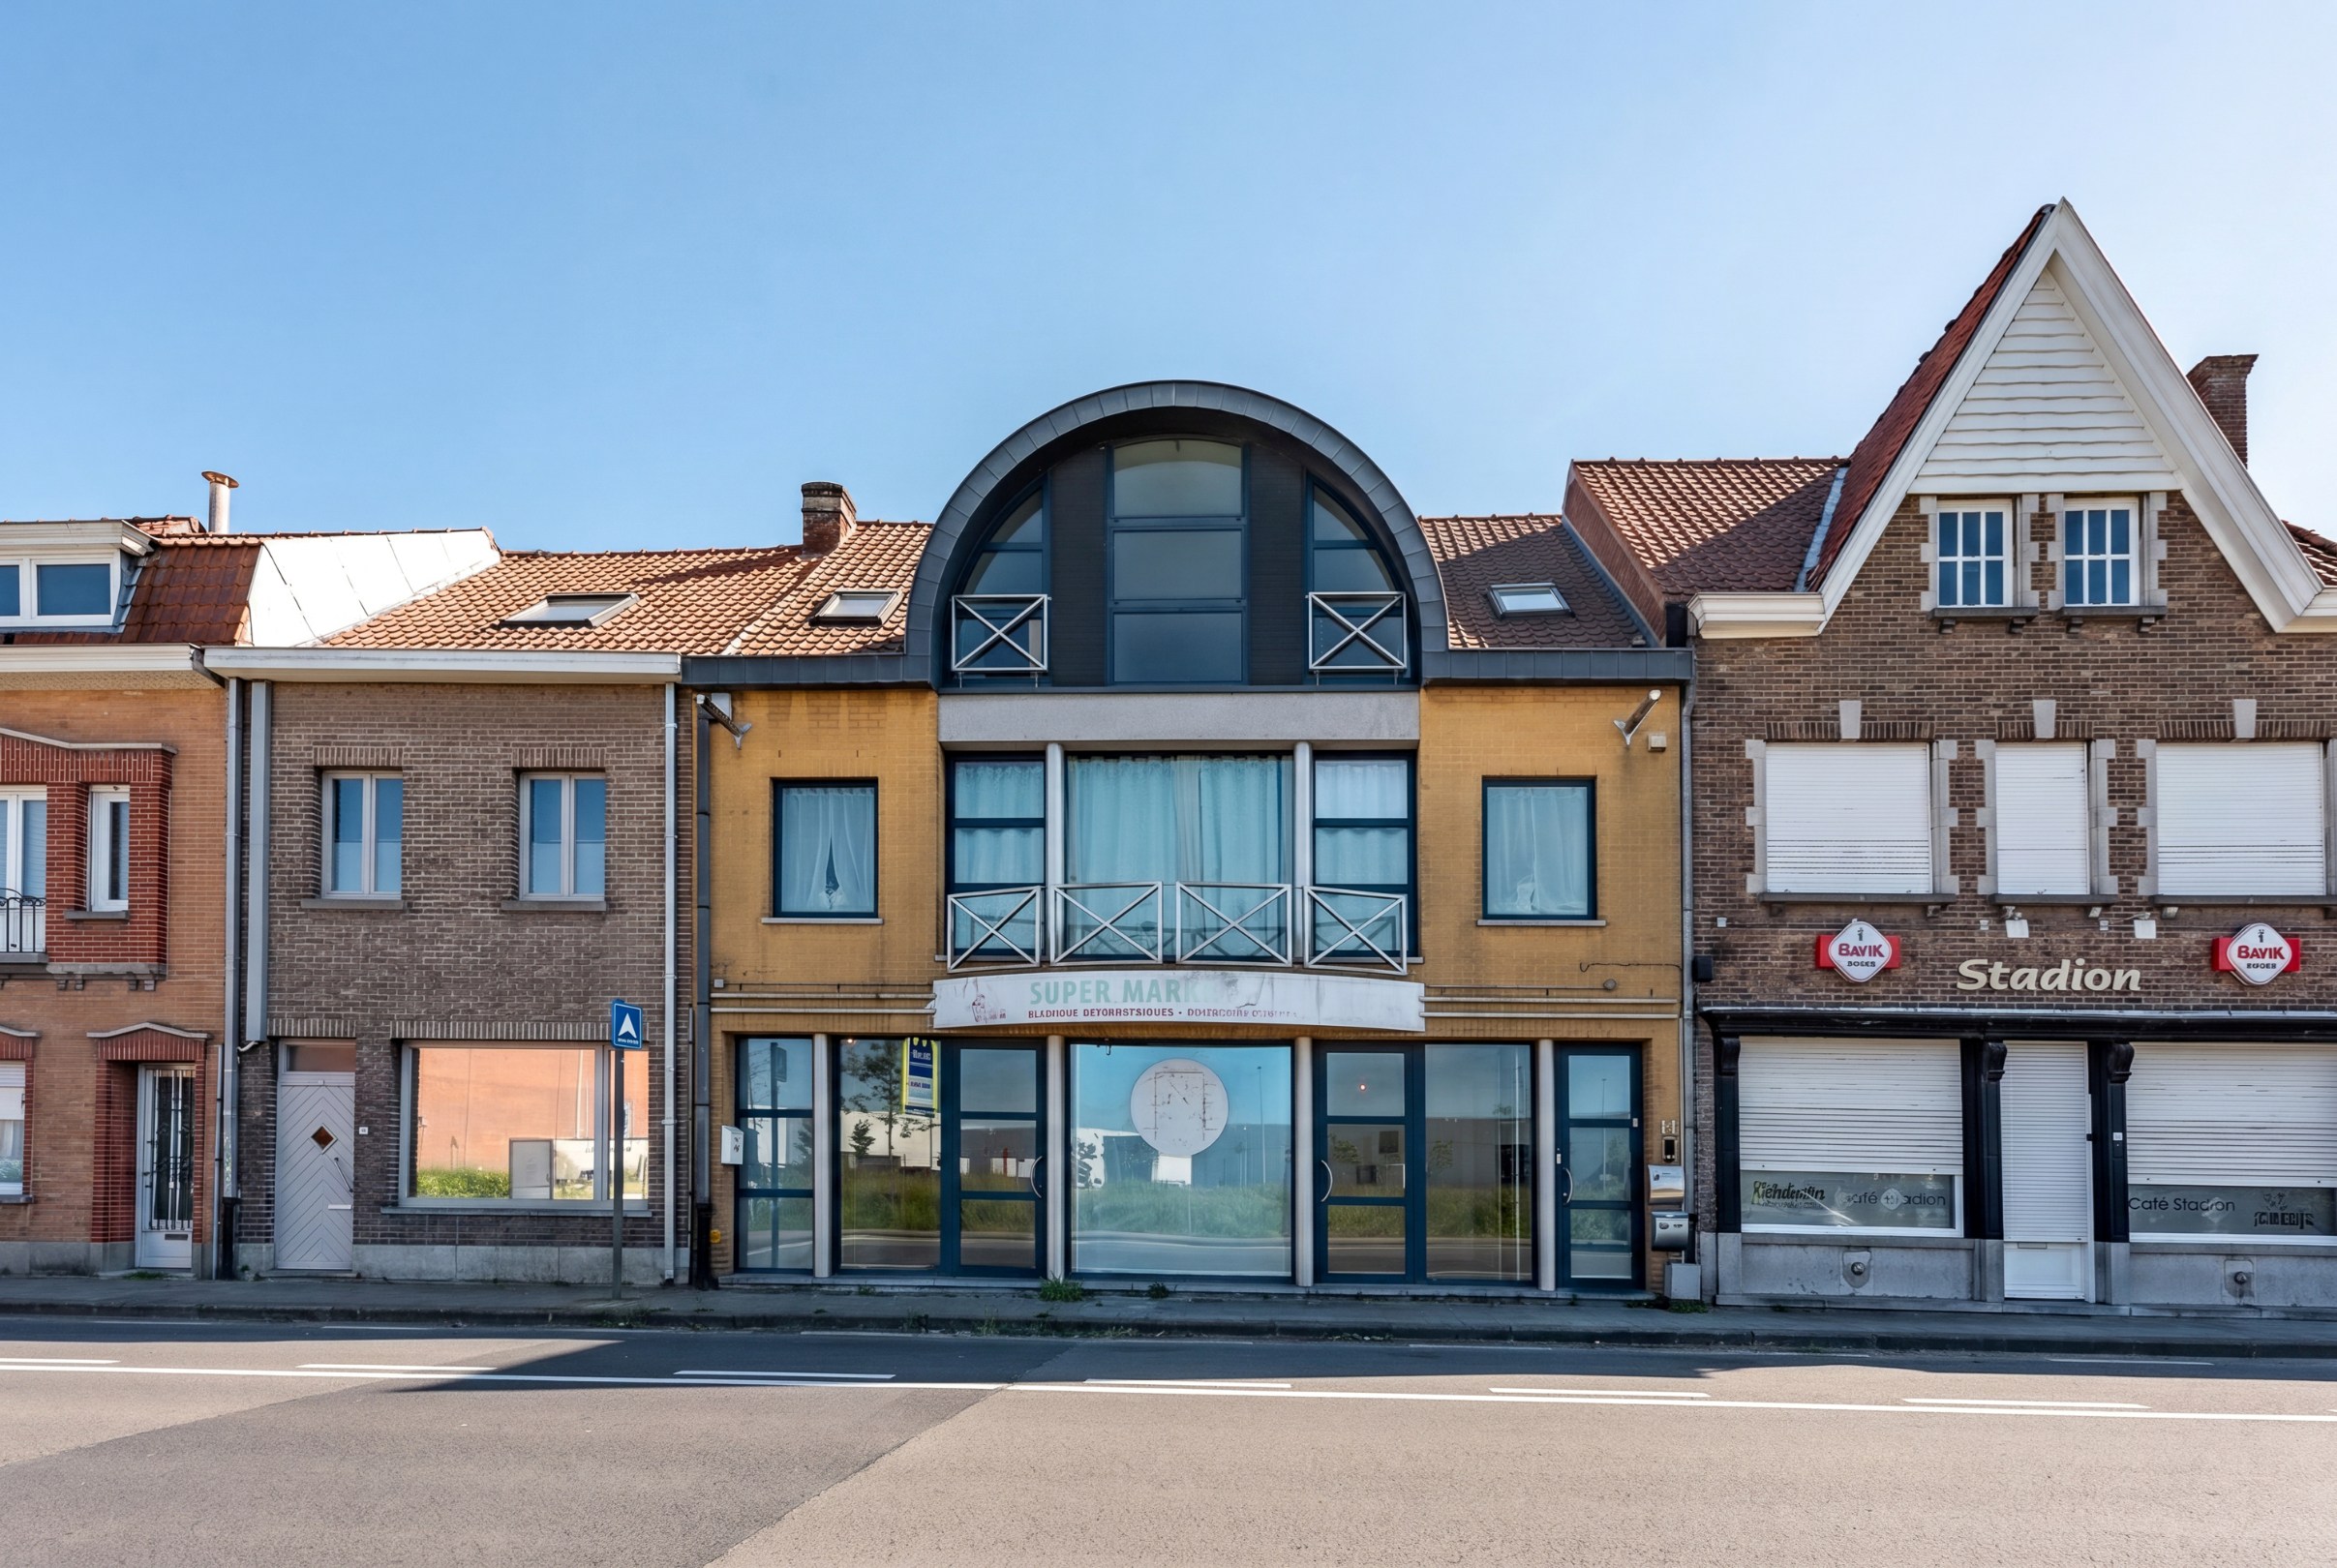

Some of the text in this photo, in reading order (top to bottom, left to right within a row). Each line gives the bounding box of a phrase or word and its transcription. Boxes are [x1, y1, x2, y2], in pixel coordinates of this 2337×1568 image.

[1837, 943, 1885, 958] BAVIK
[2236, 945, 2286, 960] BAVIK
[1957, 957, 2141, 991] Stadion
[1030, 980, 1111, 1005] SUPER
[2128, 1196, 2170, 1211] Café
